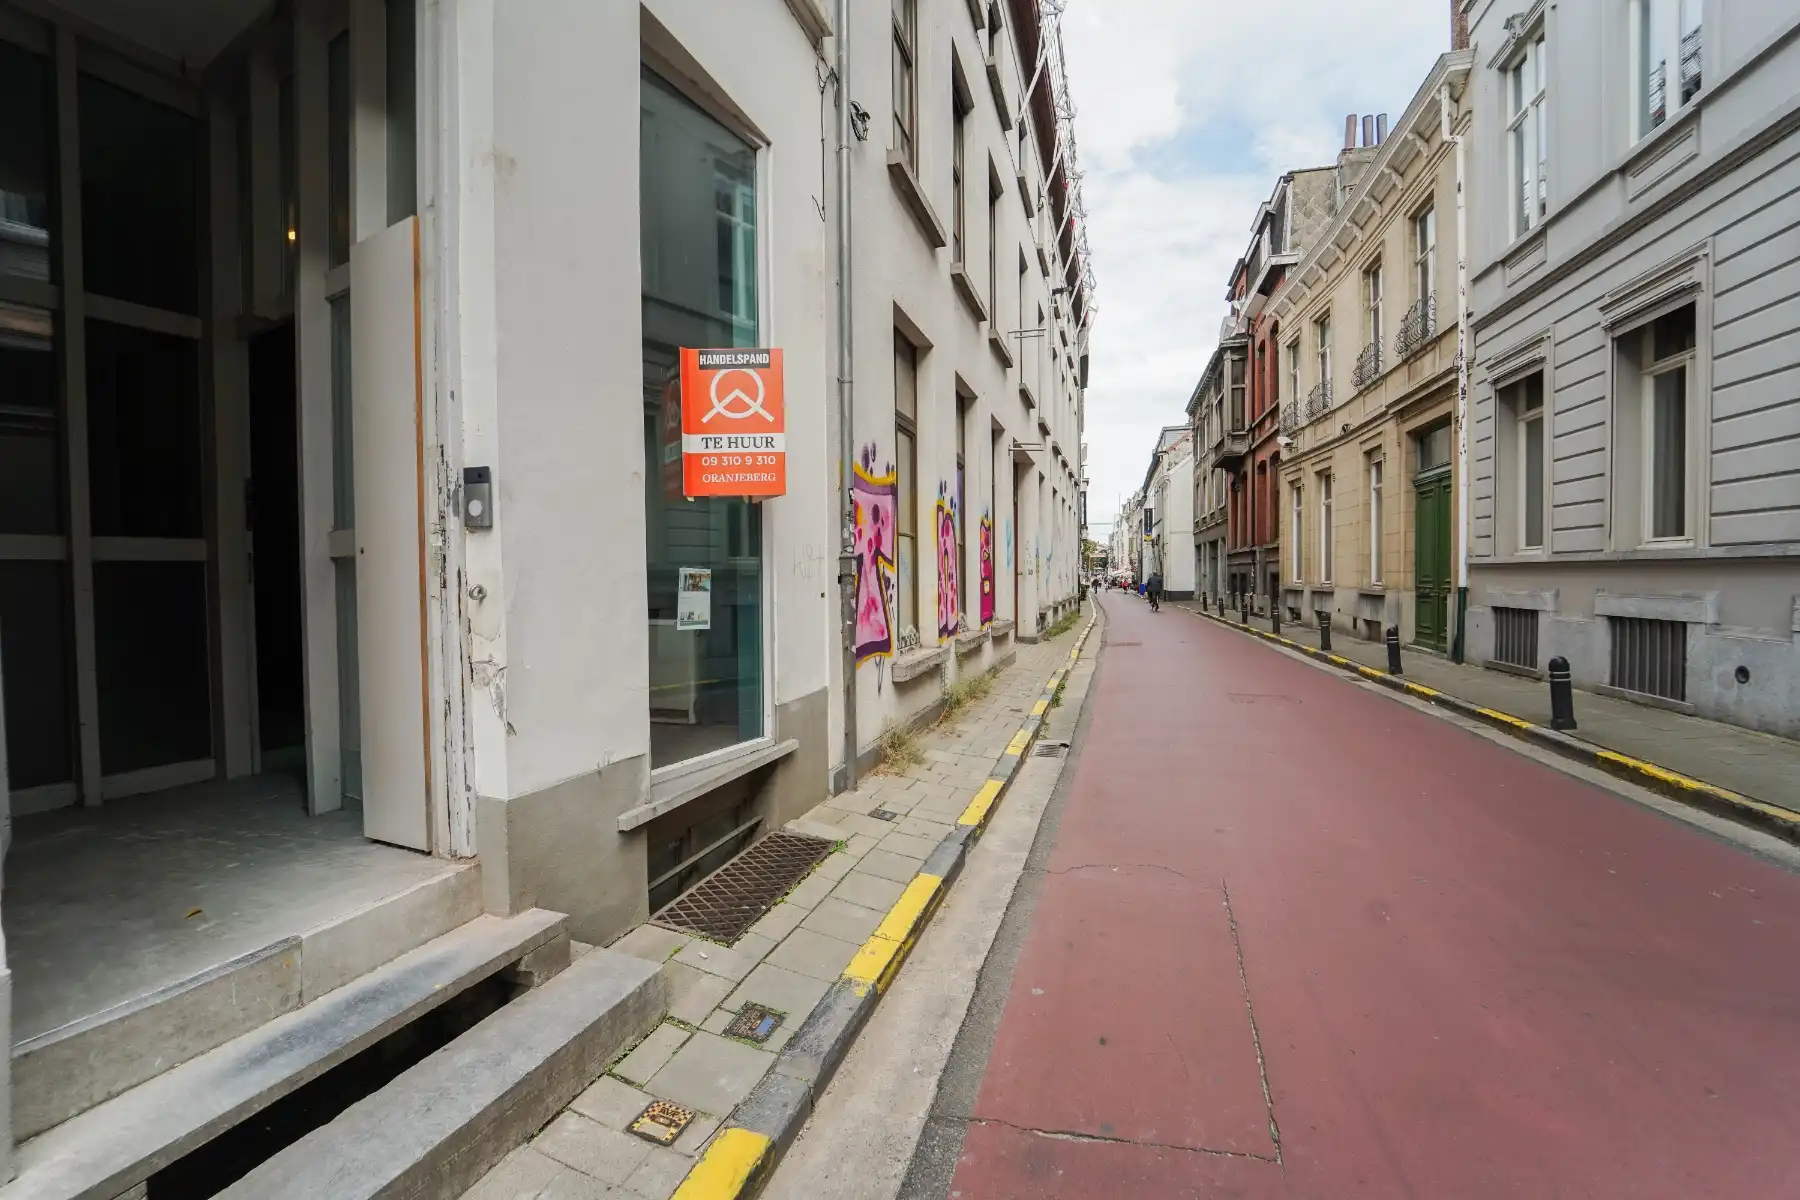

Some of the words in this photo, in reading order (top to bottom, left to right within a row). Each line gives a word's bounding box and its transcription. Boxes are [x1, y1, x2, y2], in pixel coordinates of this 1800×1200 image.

[699, 353, 769, 365] HANDELSPAND
[701, 437, 723, 449] TE
[727, 436, 776, 449] HUUR
[702, 456, 718, 466] 09
[721, 456, 742, 466] 310
[745, 455, 753, 465] 9
[756, 455, 776, 465] 310
[702, 472, 777, 483] ORANJEBERG
